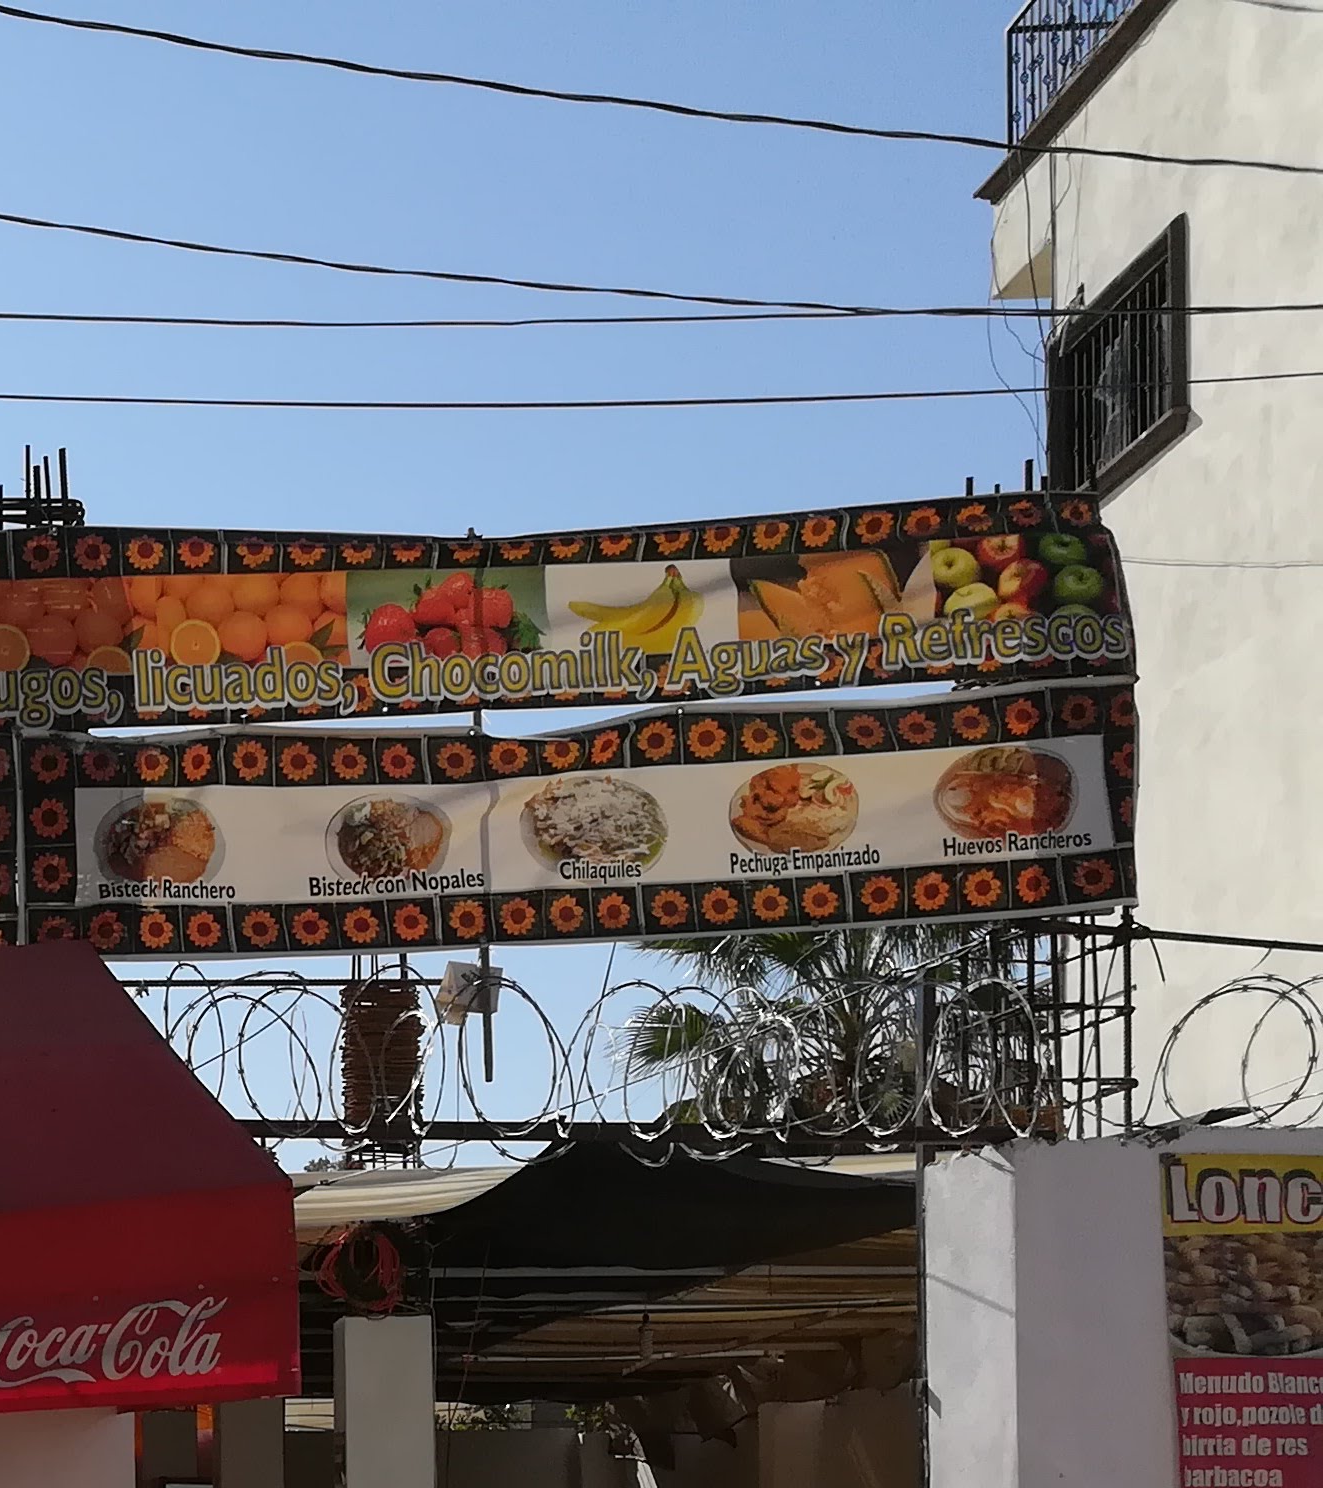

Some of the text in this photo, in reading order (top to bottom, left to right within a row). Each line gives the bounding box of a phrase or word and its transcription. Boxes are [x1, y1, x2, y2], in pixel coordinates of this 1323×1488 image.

[134, 645, 356, 712] licuados,
[368, 630, 657, 703] Chocomilk,
[666, 625, 824, 697] Aguas
[838, 630, 867, 687] y
[881, 611, 1132, 668] Refrescos
[942, 829, 1092, 857] Huevos Rancheros
[559, 857, 642, 883] Chilaquiles
[730, 843, 880, 878] Pechuga Empanizado
[98, 879, 236, 900] Bisteck Ranchero
[309, 870, 485, 899] Bisteck con Nopales
[1179, 1372, 1264, 1394] Menudo
[1180, 1407, 1190, 1427] y
[1241, 1434, 1272, 1456] de
[1276, 1437, 1308, 1456] res
